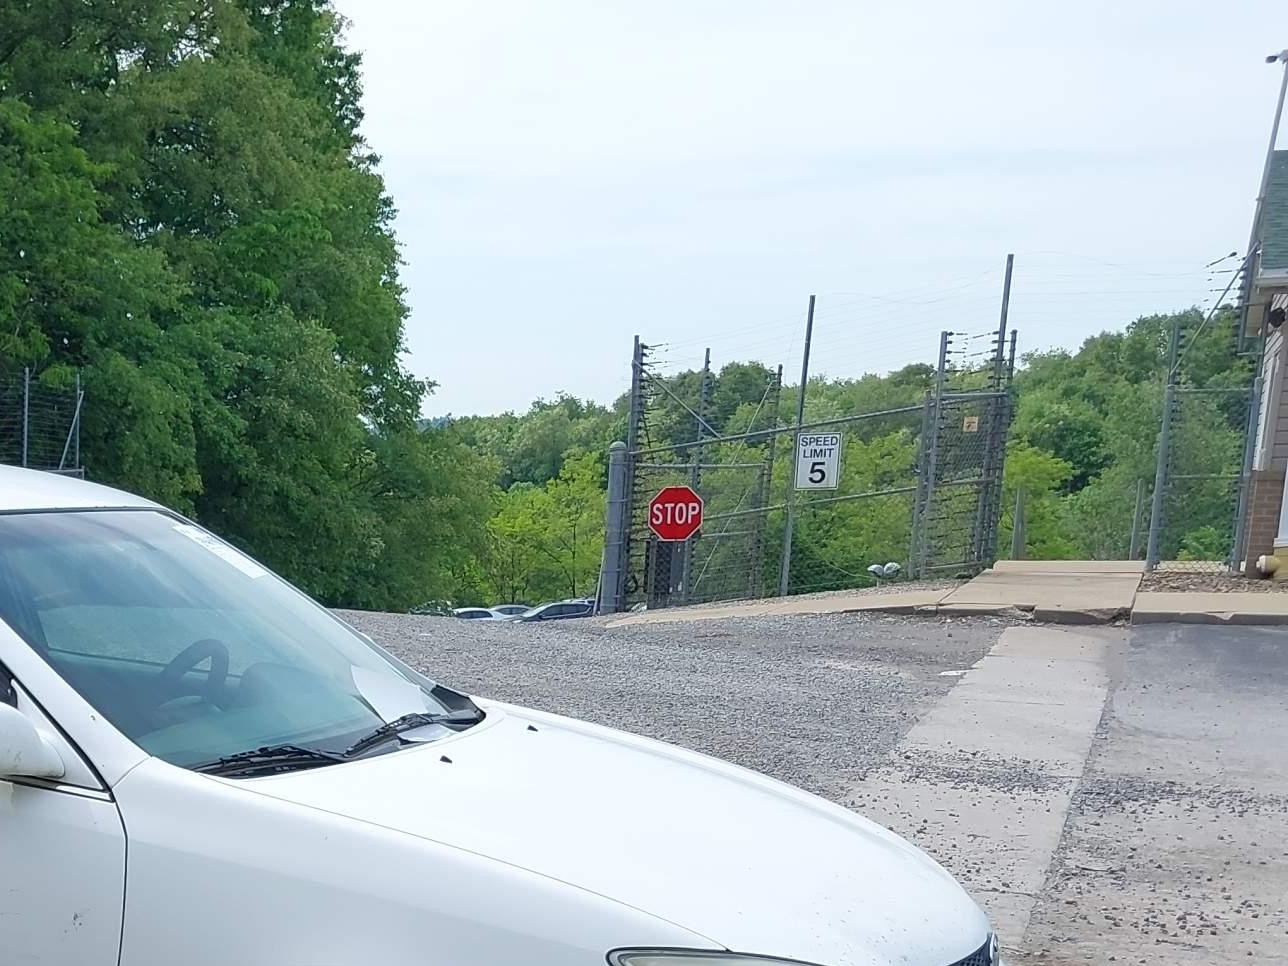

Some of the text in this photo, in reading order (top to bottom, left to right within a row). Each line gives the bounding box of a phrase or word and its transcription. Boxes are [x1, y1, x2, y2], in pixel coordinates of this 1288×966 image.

[800, 436, 838, 447] SPEED
[802, 448, 834, 459] LIMIT
[808, 461, 826, 484] 5
[652, 503, 700, 525] STOP
